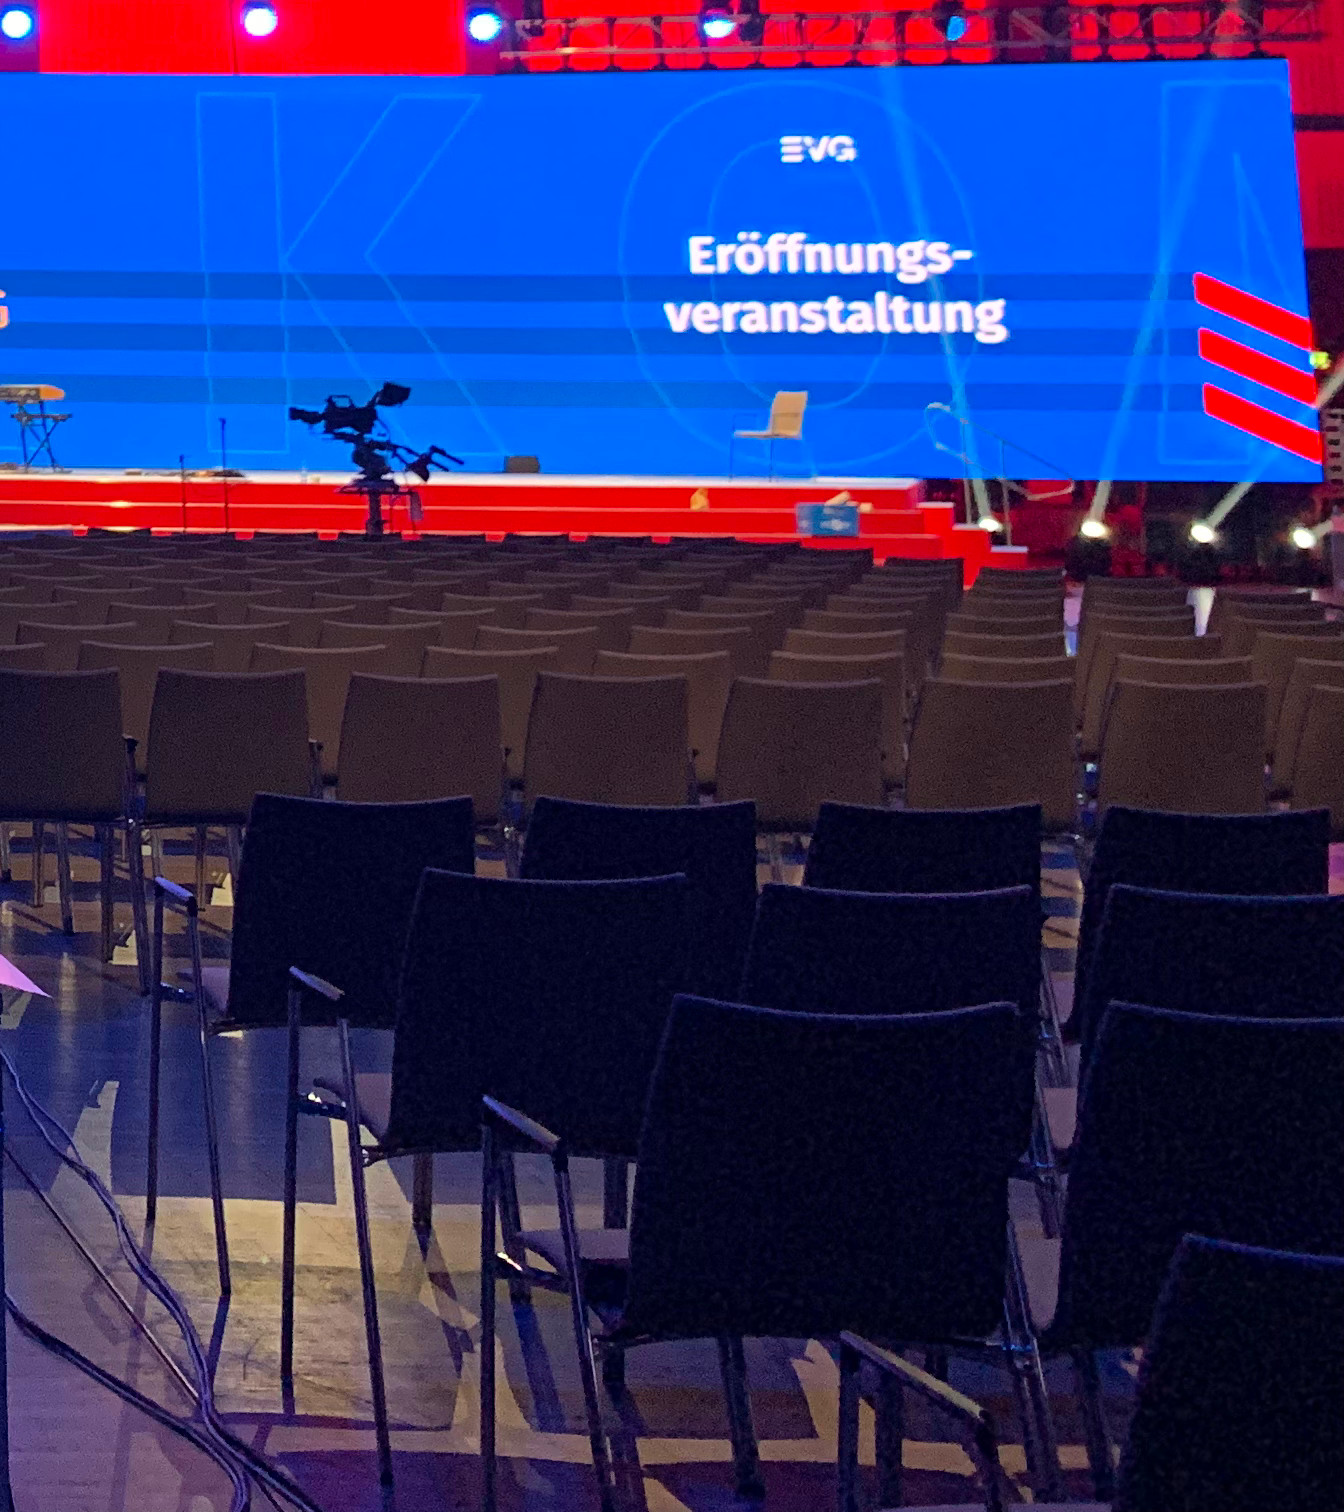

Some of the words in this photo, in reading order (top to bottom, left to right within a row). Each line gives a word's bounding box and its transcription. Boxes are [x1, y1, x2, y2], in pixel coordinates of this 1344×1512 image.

[779, 135, 857, 163] EVG
[688, 231, 973, 284] Eröffnungs-
[663, 291, 1009, 344] veranstaltung
